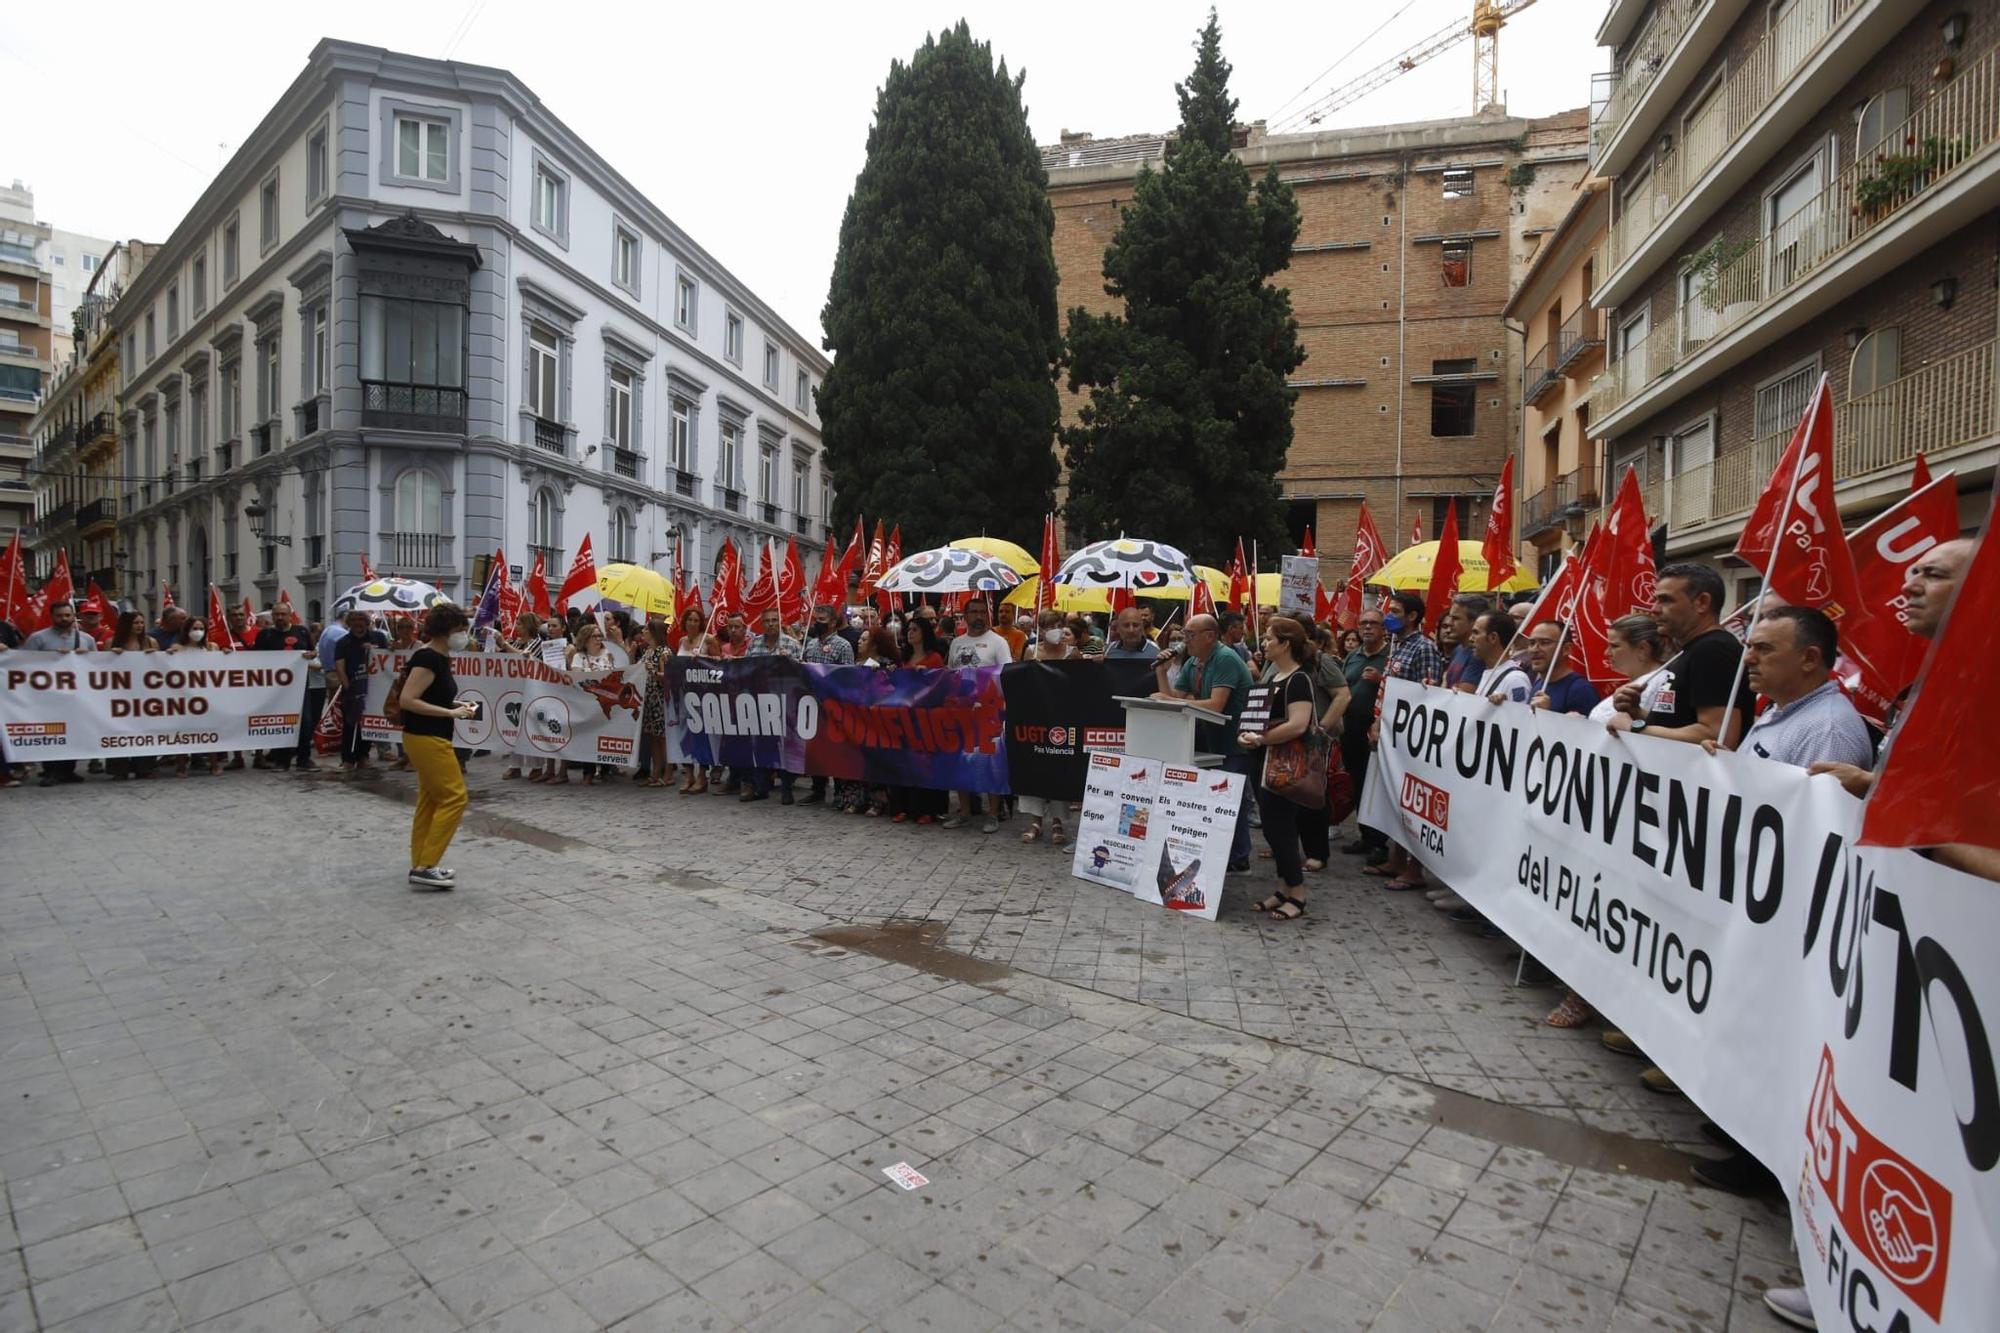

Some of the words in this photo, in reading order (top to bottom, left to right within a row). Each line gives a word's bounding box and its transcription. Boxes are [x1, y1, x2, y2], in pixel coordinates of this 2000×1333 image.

[8, 670, 77, 690] POR
[88, 671, 132, 690] UN
[143, 668, 293, 690] CONVENIO
[111, 696, 208, 717] DIGNO
[250, 716, 284, 725] CCOO
[684, 692, 787, 737] SALARI
[797, 695, 819, 740] O
[824, 697, 1001, 755] CONFLICTE
[101, 736, 154, 748] SECTOR
[158, 731, 219, 745] PLÁSTICO
[1015, 725, 1047, 743] UGT
[600, 740, 632, 752] CCOO
[597, 754, 628, 765] serveis
[1166, 770, 1188, 779] CCOO
[1087, 785, 1100, 794] Per
[1104, 789, 1114, 797] un
[1121, 793, 1153, 805] conveni
[1402, 777, 1433, 817] UGT
[1083, 810, 1105, 821] digne
[1159, 796, 1171, 805] Els
[1177, 800, 1207, 812] nostres
[1215, 807, 1237, 818] drets
[1166, 809, 1176, 817] no
[1202, 816, 1213, 824] es
[1392, 699, 1449, 768] POR
[1455, 717, 1519, 793] UN
[1525, 735, 1784, 925] CONVENIO
[1171, 824, 1208, 839] trepitgen
[1420, 823, 1444, 857] FICA
[1518, 845, 1549, 903] del
[1555, 865, 1713, 1015] PLÁSTICO
